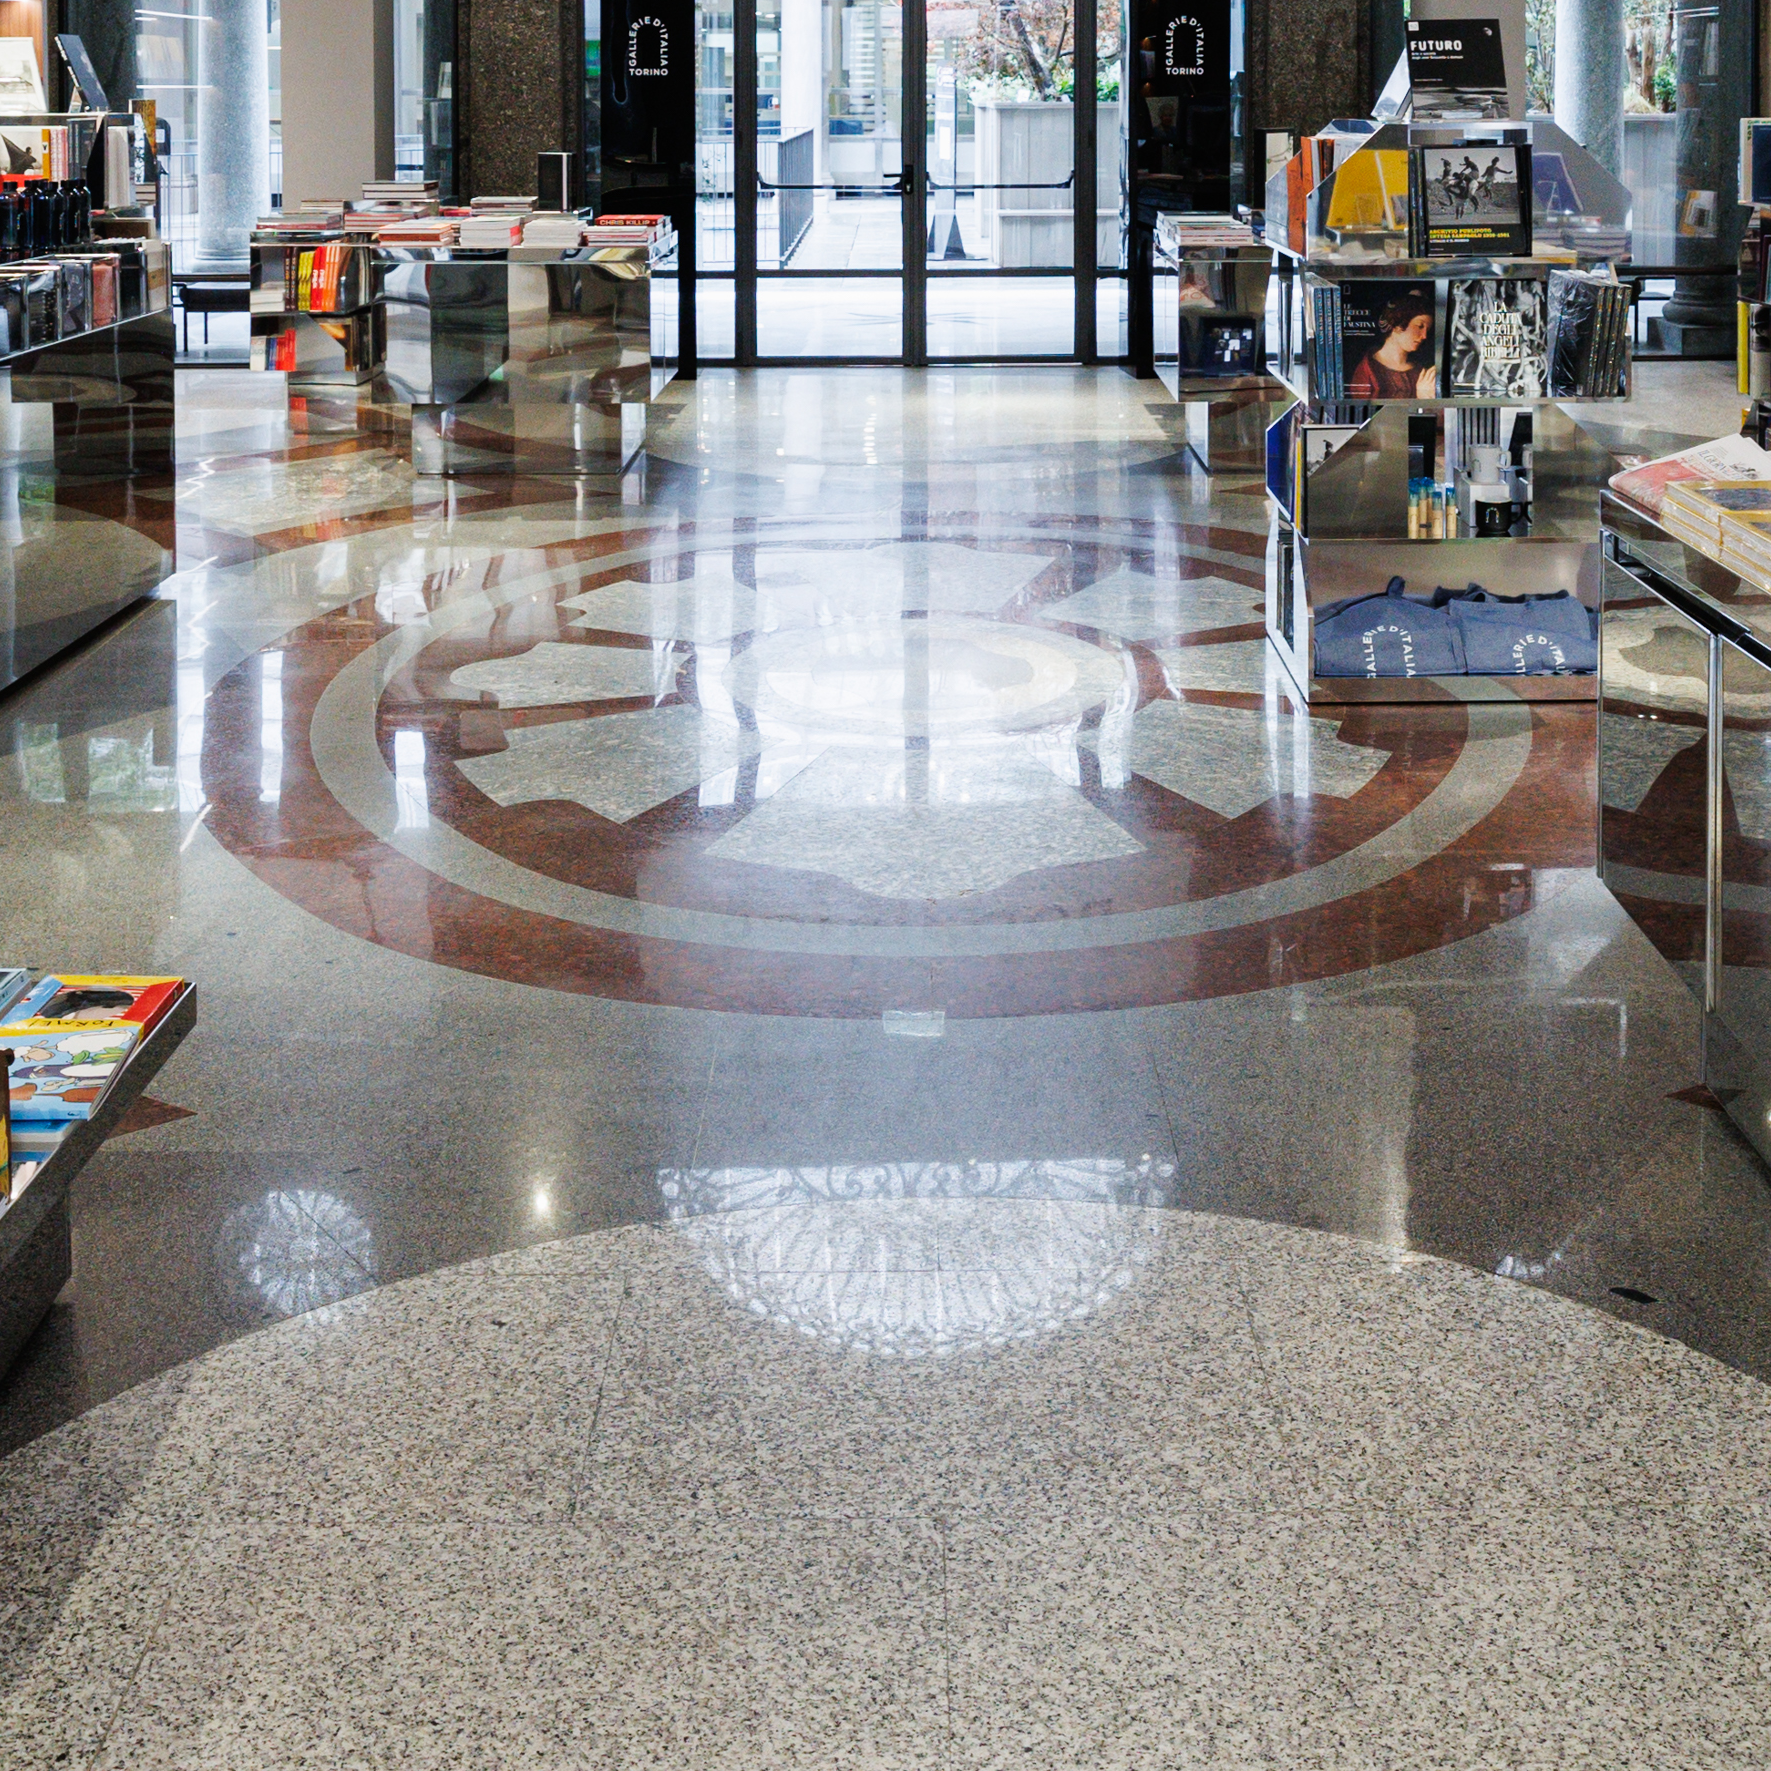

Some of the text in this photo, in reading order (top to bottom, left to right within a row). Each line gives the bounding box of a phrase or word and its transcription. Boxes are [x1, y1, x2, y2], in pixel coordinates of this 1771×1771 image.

[628, 16, 669, 67] GALLERIE D'ITALIA
[1165, 15, 1205, 66] GALLERIE D'ITALIA
[1410, 40, 1462, 51] FUTURO
[628, 68, 669, 76] TORINO
[1165, 67, 1205, 75] TORINO
[1494, 301, 1507, 313] LA
[1479, 312, 1522, 324] CADUTA
[1483, 324, 1518, 335] DEGLI
[1480, 335, 1520, 346] ANGELI
[1480, 346, 1520, 358] RIBELLI
[1513, 634, 1536, 674] LLERIE
